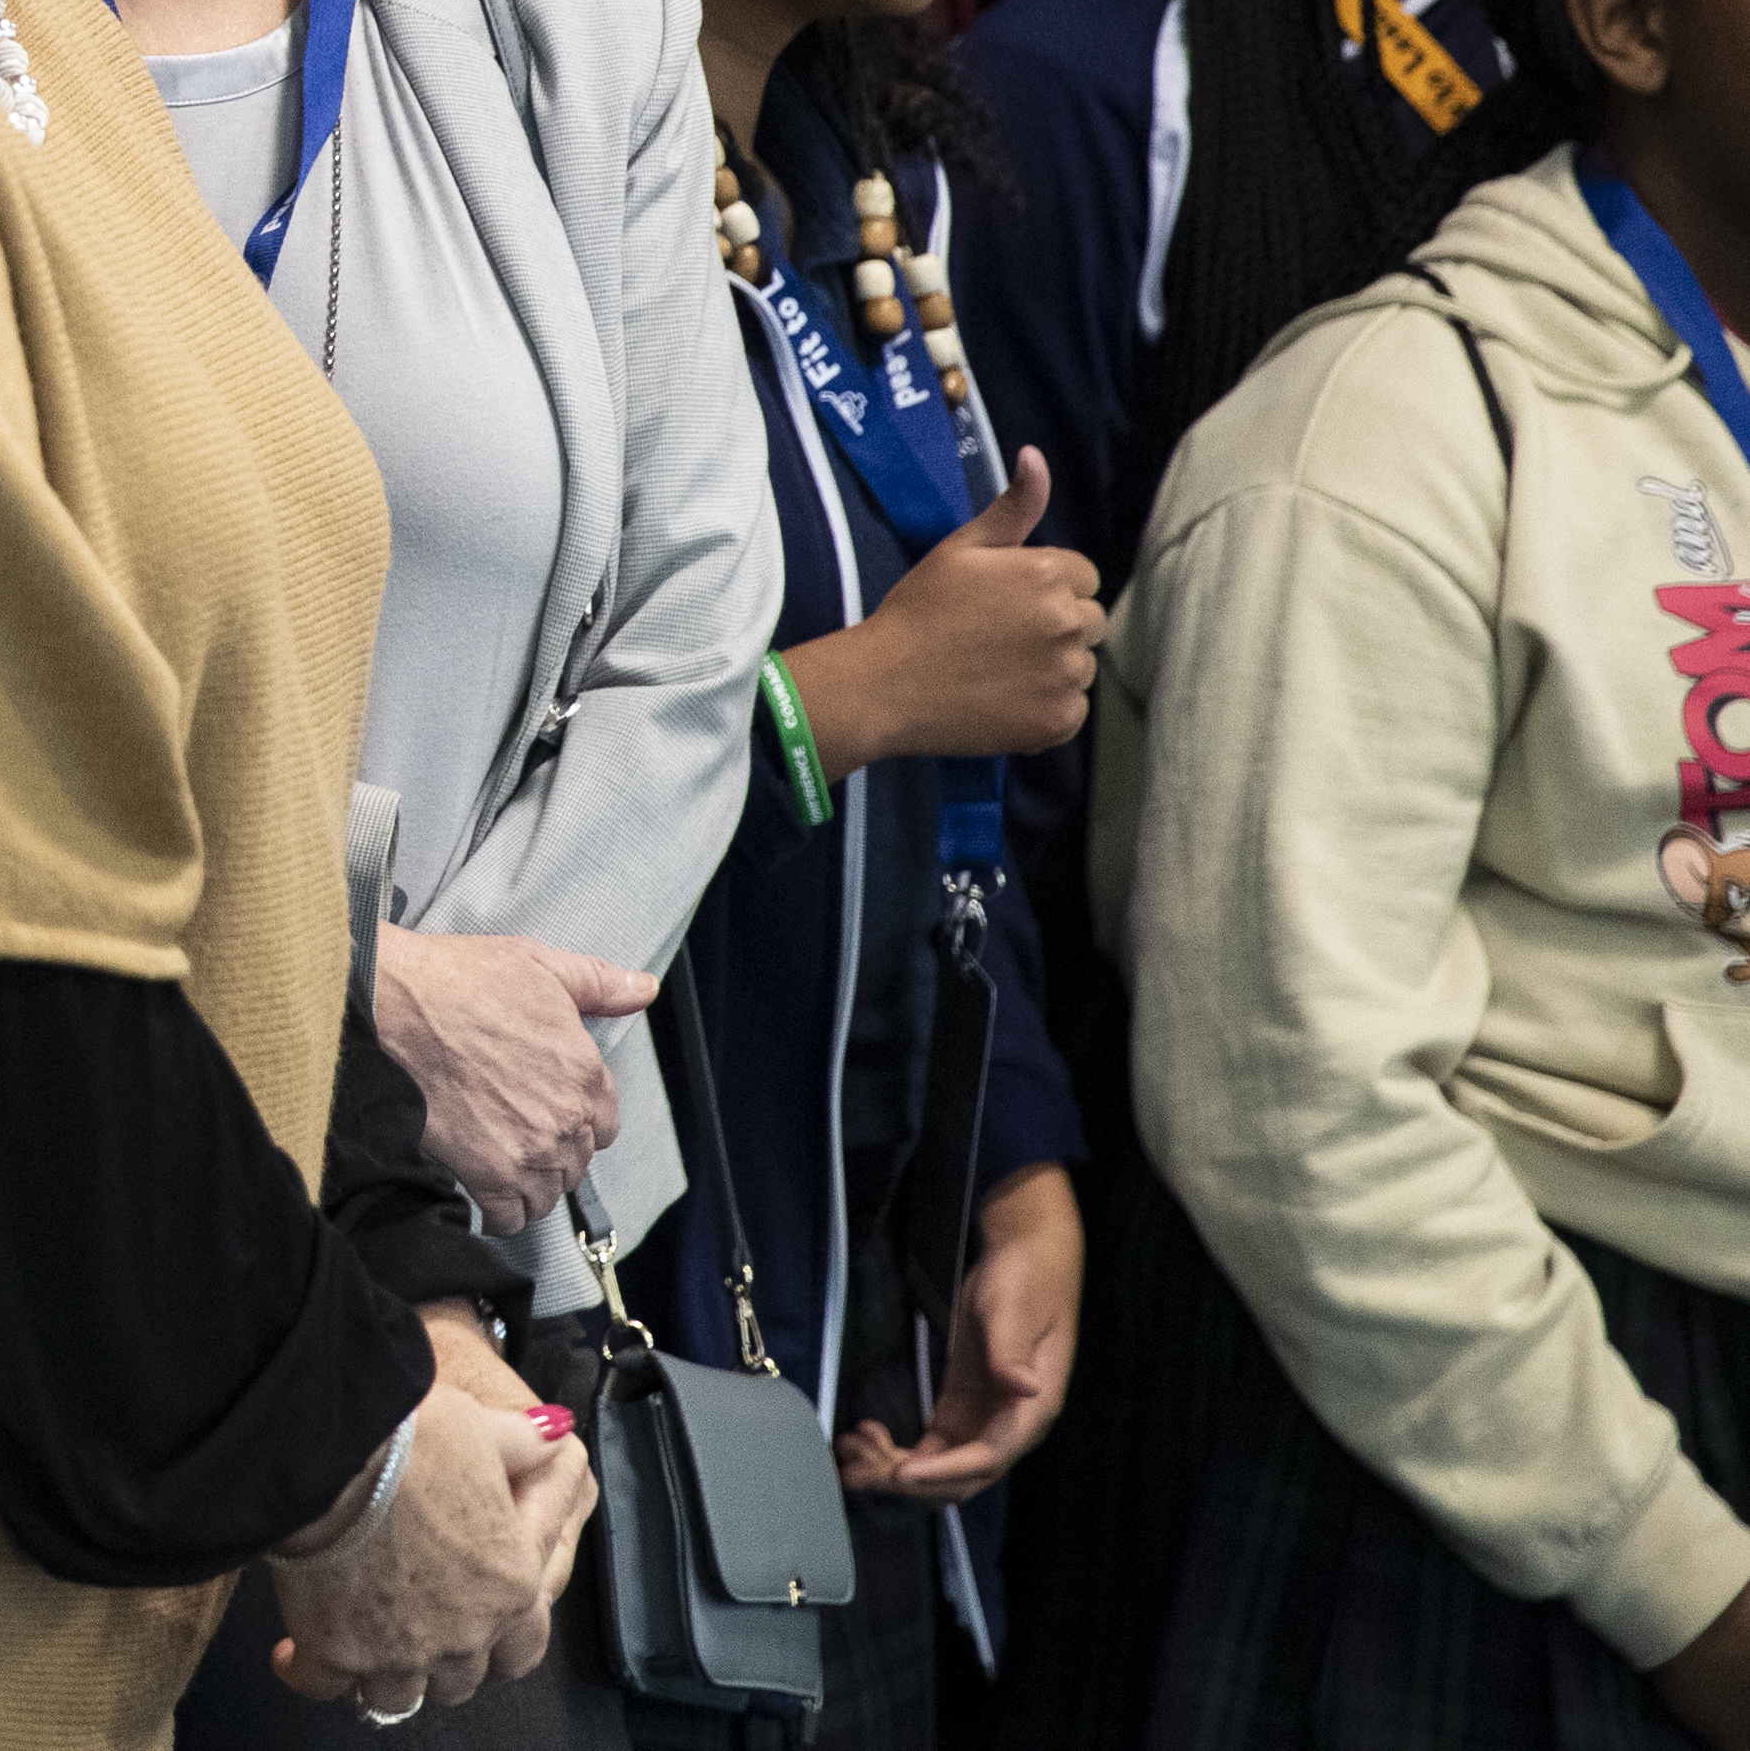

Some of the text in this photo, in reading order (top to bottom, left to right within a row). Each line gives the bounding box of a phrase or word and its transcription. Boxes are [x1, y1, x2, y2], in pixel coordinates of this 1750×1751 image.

[778, 296, 842, 391] Fit to
[882, 327, 931, 410] Lead
